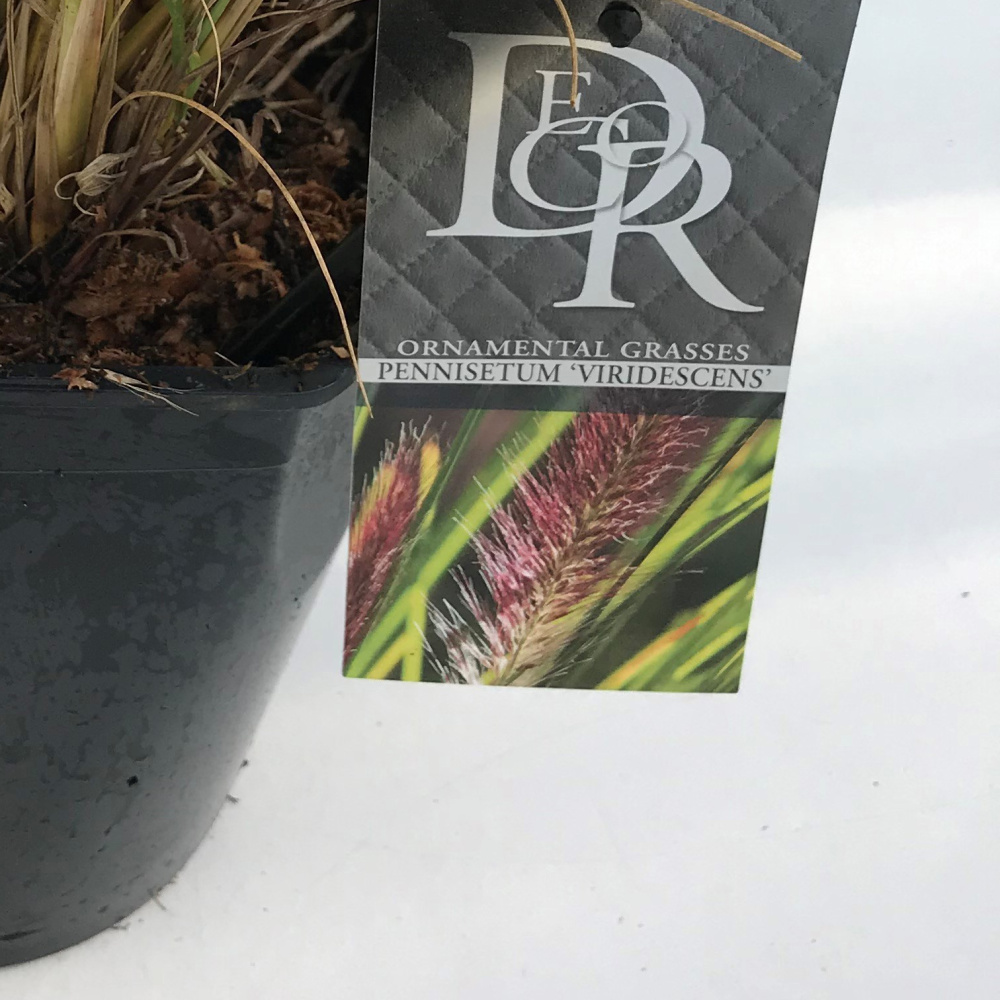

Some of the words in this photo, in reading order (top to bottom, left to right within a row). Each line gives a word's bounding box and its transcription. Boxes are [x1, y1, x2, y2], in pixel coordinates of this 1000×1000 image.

[397, 339, 610, 358] ORNAMENTAL
[620, 341, 750, 361] GRASSES
[377, 361, 562, 383] PENNISETUM
